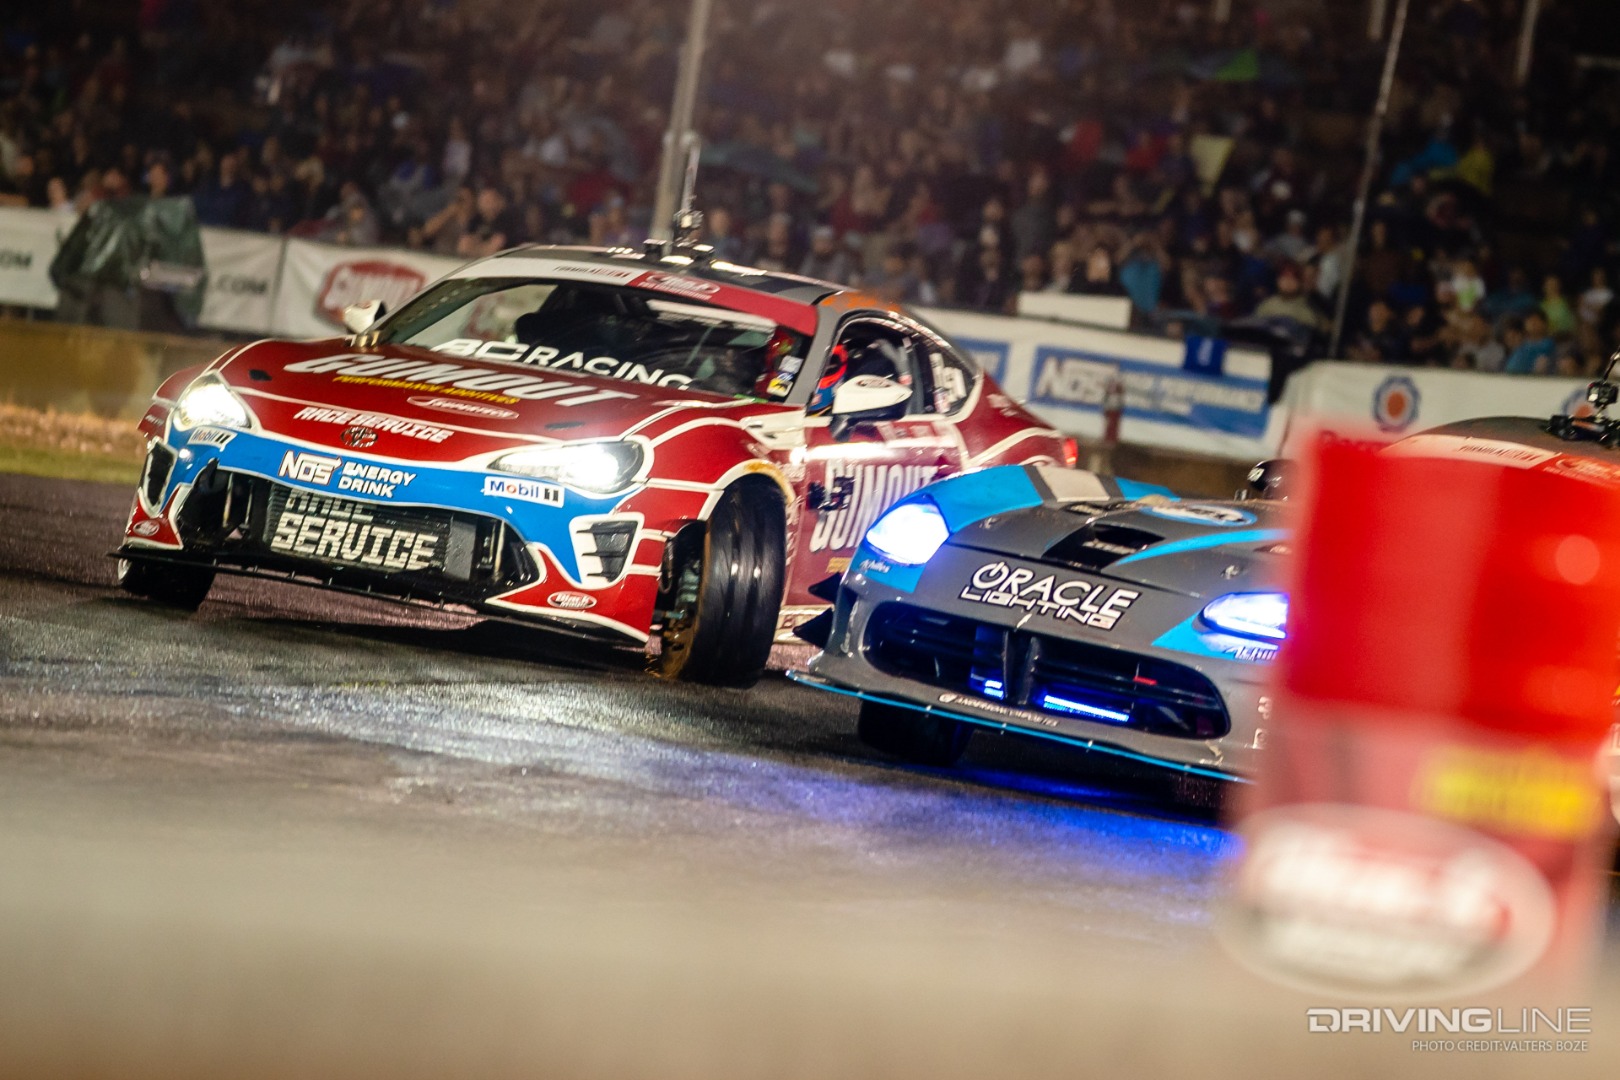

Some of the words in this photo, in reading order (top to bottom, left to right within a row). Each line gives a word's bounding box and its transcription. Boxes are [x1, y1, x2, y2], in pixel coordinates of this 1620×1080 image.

[283, 353, 640, 408] GUMOUT
[293, 406, 352, 426] RACE
[347, 412, 455, 443] SERVICE
[278, 449, 343, 486] NOS
[342, 461, 417, 487] ENERGY
[337, 475, 397, 498] DRINK
[489, 479, 540, 499] Mobil
[270, 511, 439, 572] SERVICE
[960, 585, 1119, 631] LIGHTING
[972, 561, 1141, 619] ORACLE
